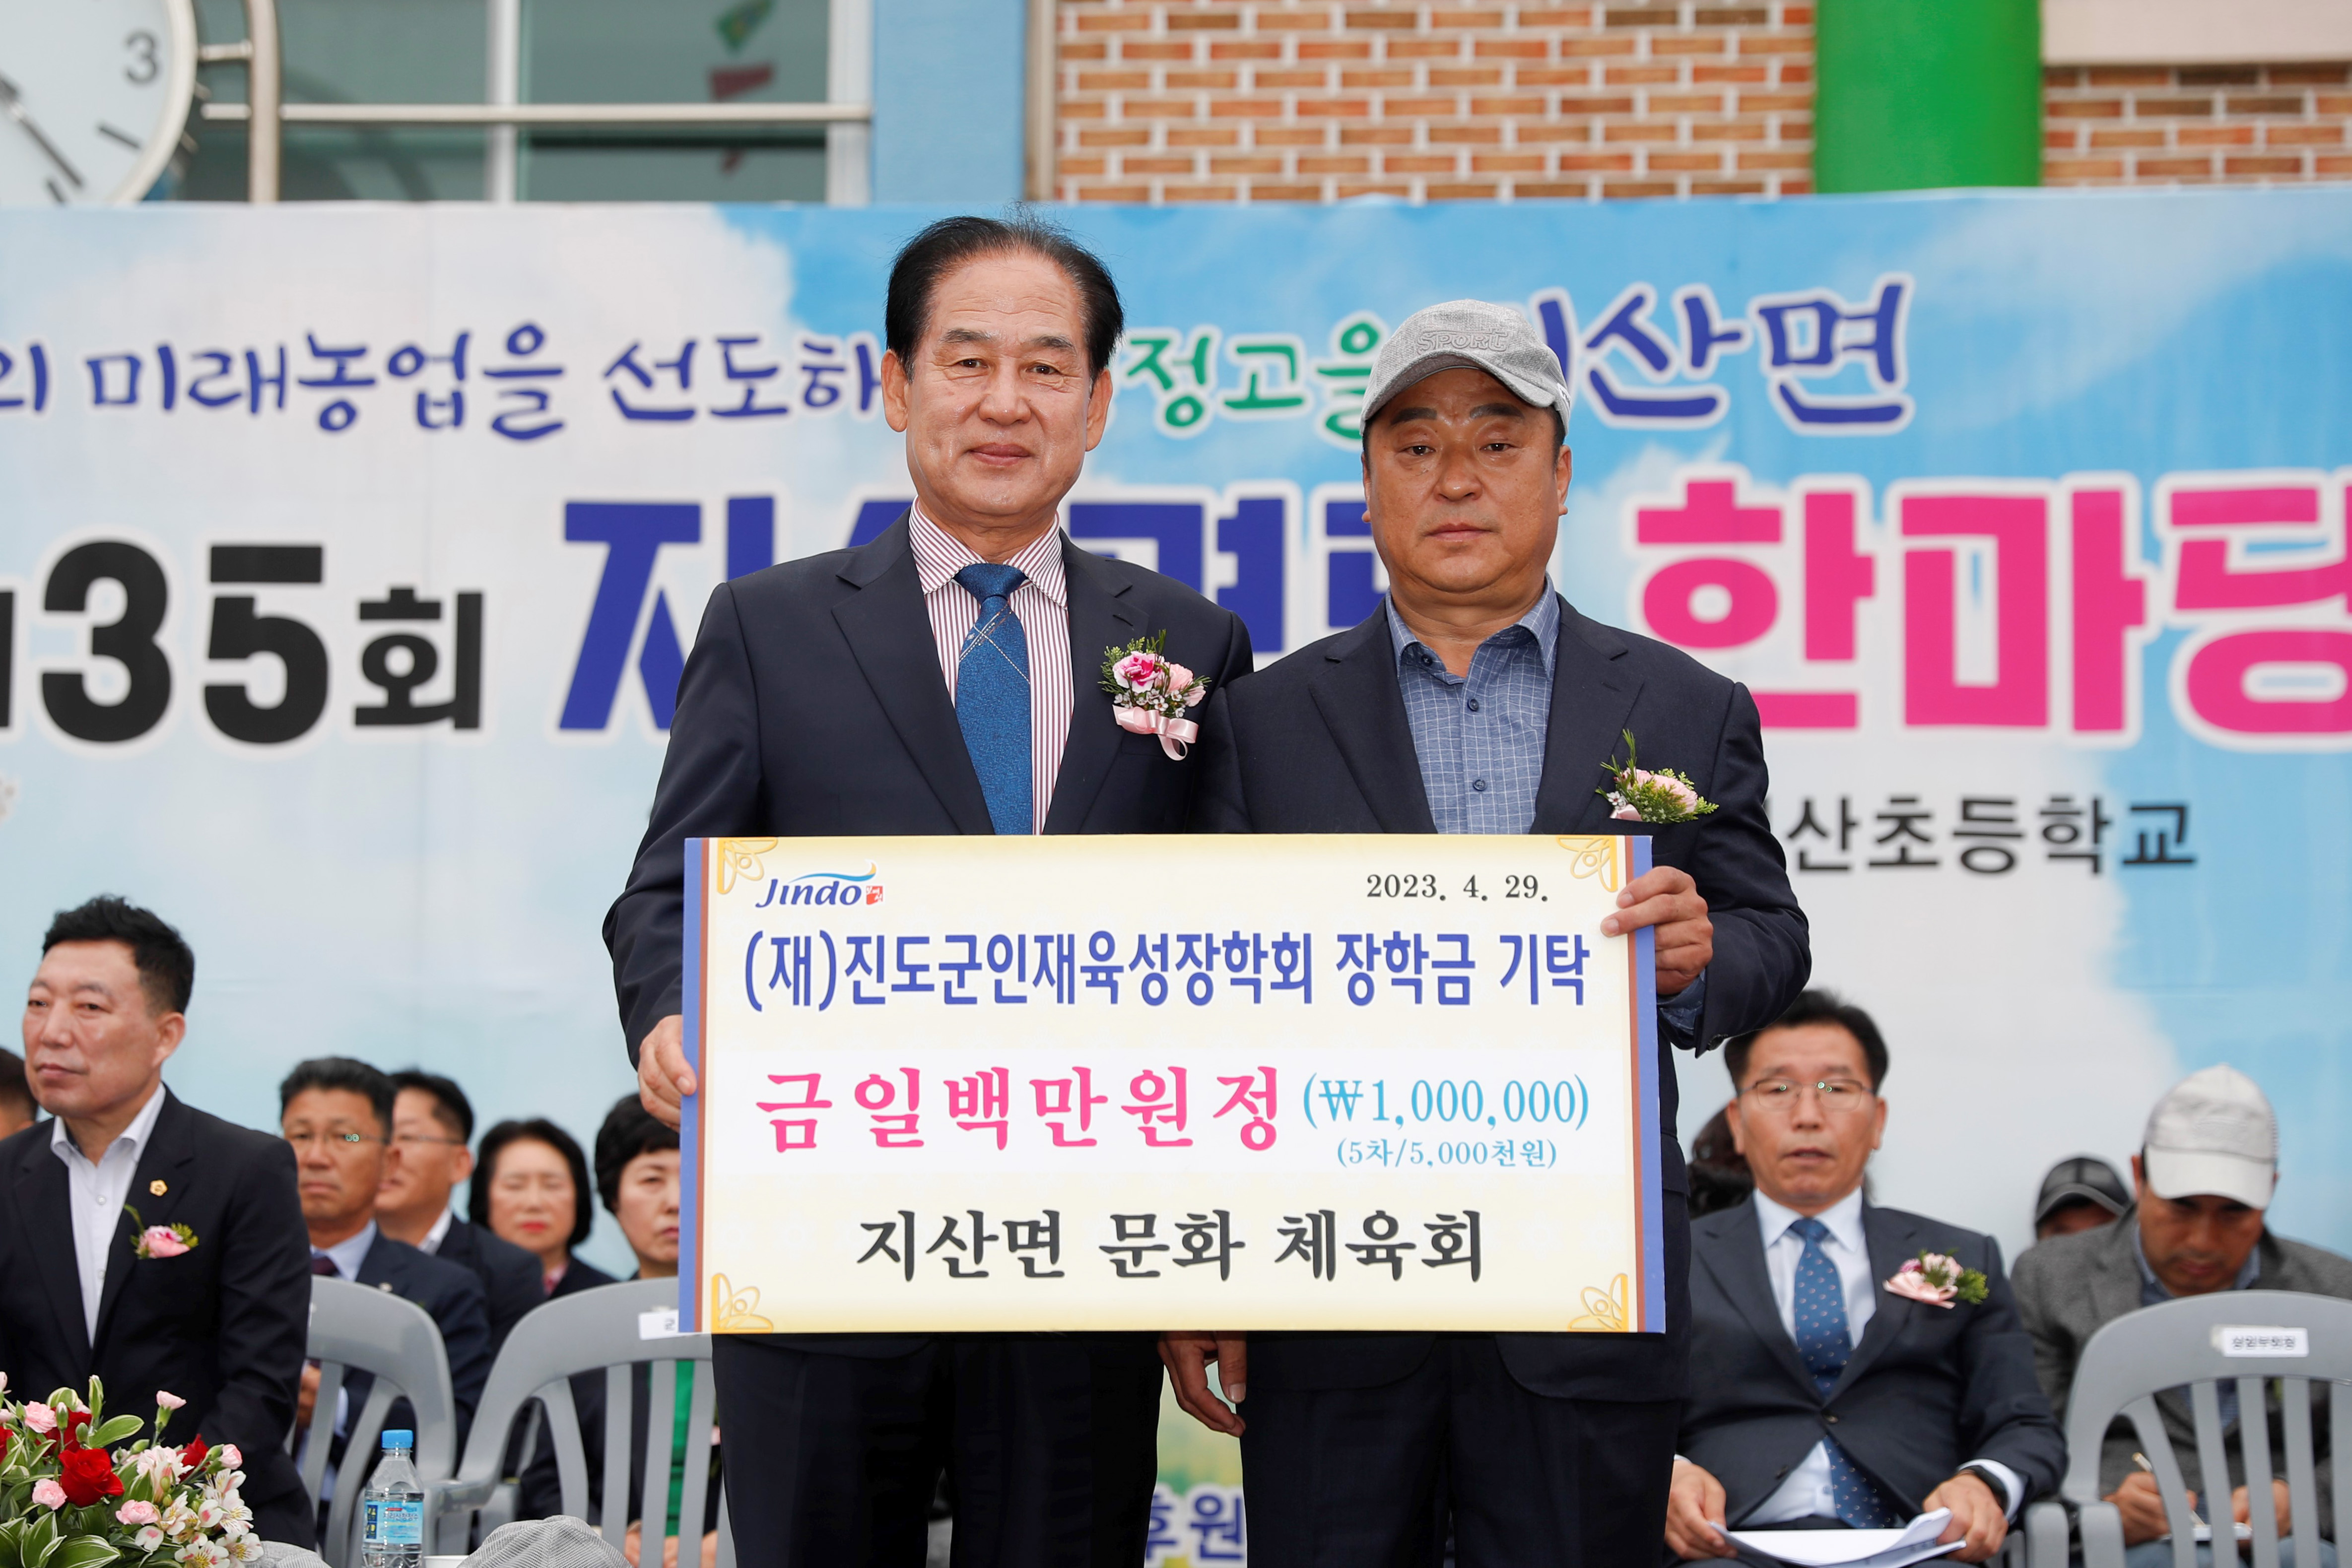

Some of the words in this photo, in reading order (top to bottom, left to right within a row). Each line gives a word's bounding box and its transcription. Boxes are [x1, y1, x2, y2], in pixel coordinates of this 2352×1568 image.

[123, 31, 160, 86] 3
[1417, 329, 1508, 354] SPORT
[1539, 284, 1905, 426] 산면
[85, 323, 566, 442] 미래농업을
[0, 539, 483, 745] 35회
[1636, 479, 2352, 735] 한마당
[1765, 792, 2198, 875] 산초등학교
[755, 879, 862, 908] Jindo
[1367, 874, 1446, 901] 2023.
[1463, 874, 1488, 902] 4.
[1505, 875, 1548, 902] 29.
[745, 929, 1313, 1012] (재)진도군인재육성장학회
[1336, 930, 1476, 1007] 장학금
[1500, 933, 1590, 1006] 기탁
[1303, 1072, 1589, 1130] (₩1,000,000)
[1337, 1138, 1557, 1169] (5차/5,000천원)
[856, 1209, 1066, 1283] 지산면
[1098, 1209, 1246, 1282] 문화
[1274, 1209, 1481, 1283] 체육회
[1145, 1494, 1244, 1562] 후원
